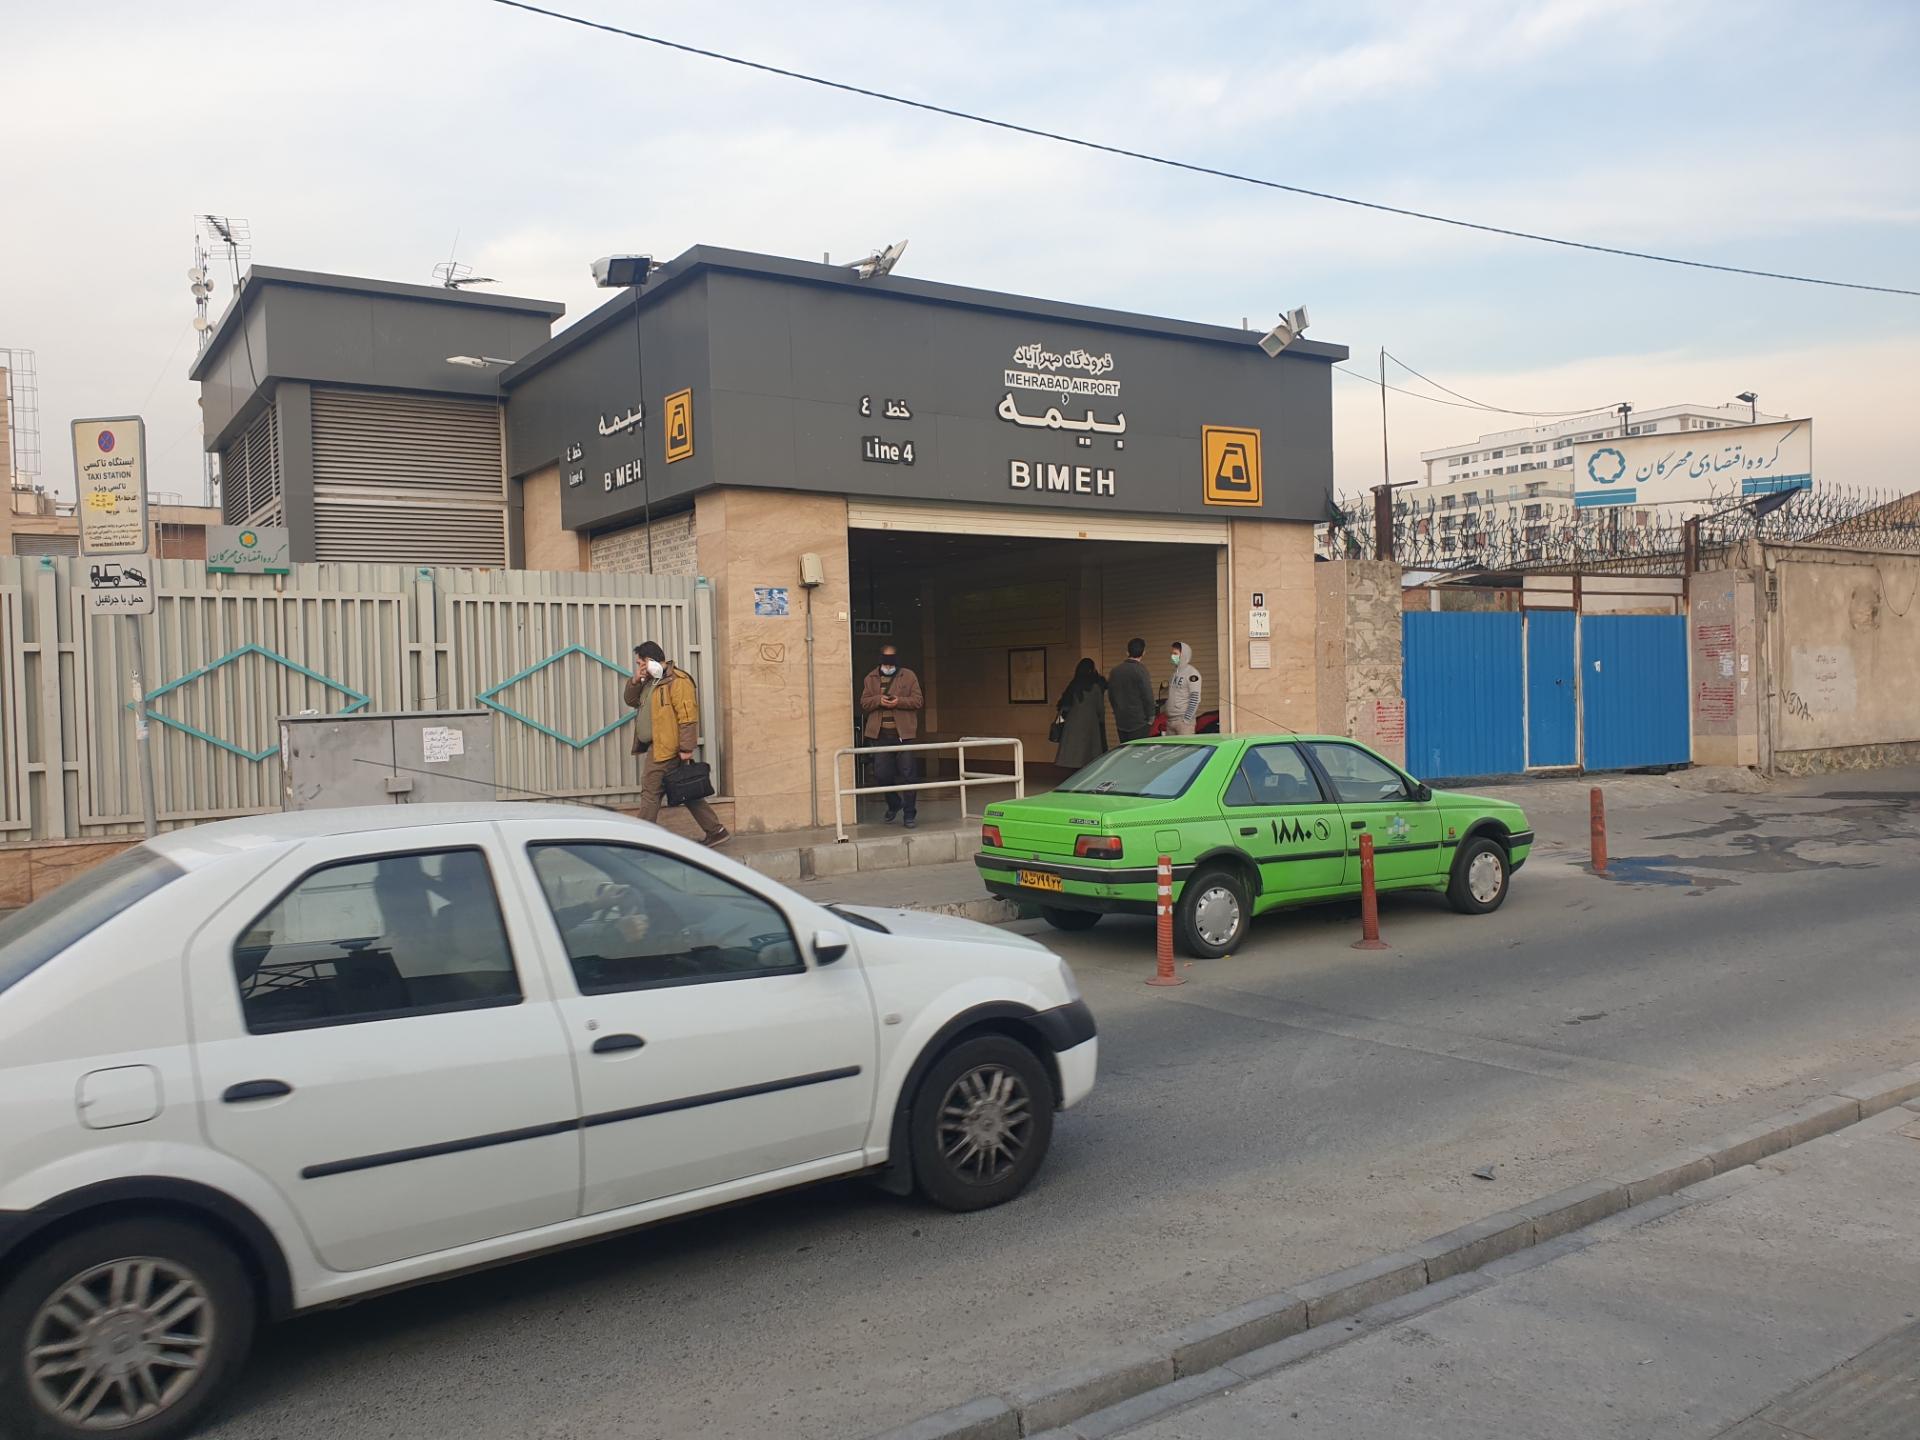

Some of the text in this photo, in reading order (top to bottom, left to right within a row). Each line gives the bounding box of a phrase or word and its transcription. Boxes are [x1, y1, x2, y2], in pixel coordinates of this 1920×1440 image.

[1013, 343, 1114, 375] فرودگاه مهرآباد
[1005, 372, 1119, 396] MEHRABAD AIRPORT
[598, 403, 643, 436] بیمه
[885, 400, 910, 418] خط
[998, 392, 1127, 449] بیمه
[865, 437, 914, 462] Line 4
[83, 457, 135, 471] ایستگاه تاکسی
[87, 470, 132, 481] TAXI STATION
[604, 459, 641, 492] BMEH
[1010, 460, 1115, 496] BIMEH
[95, 594, 120, 607] جرثقیل
[127, 593, 144, 607] حمل
[1270, 817, 1313, 845] ۱۸۸۰
